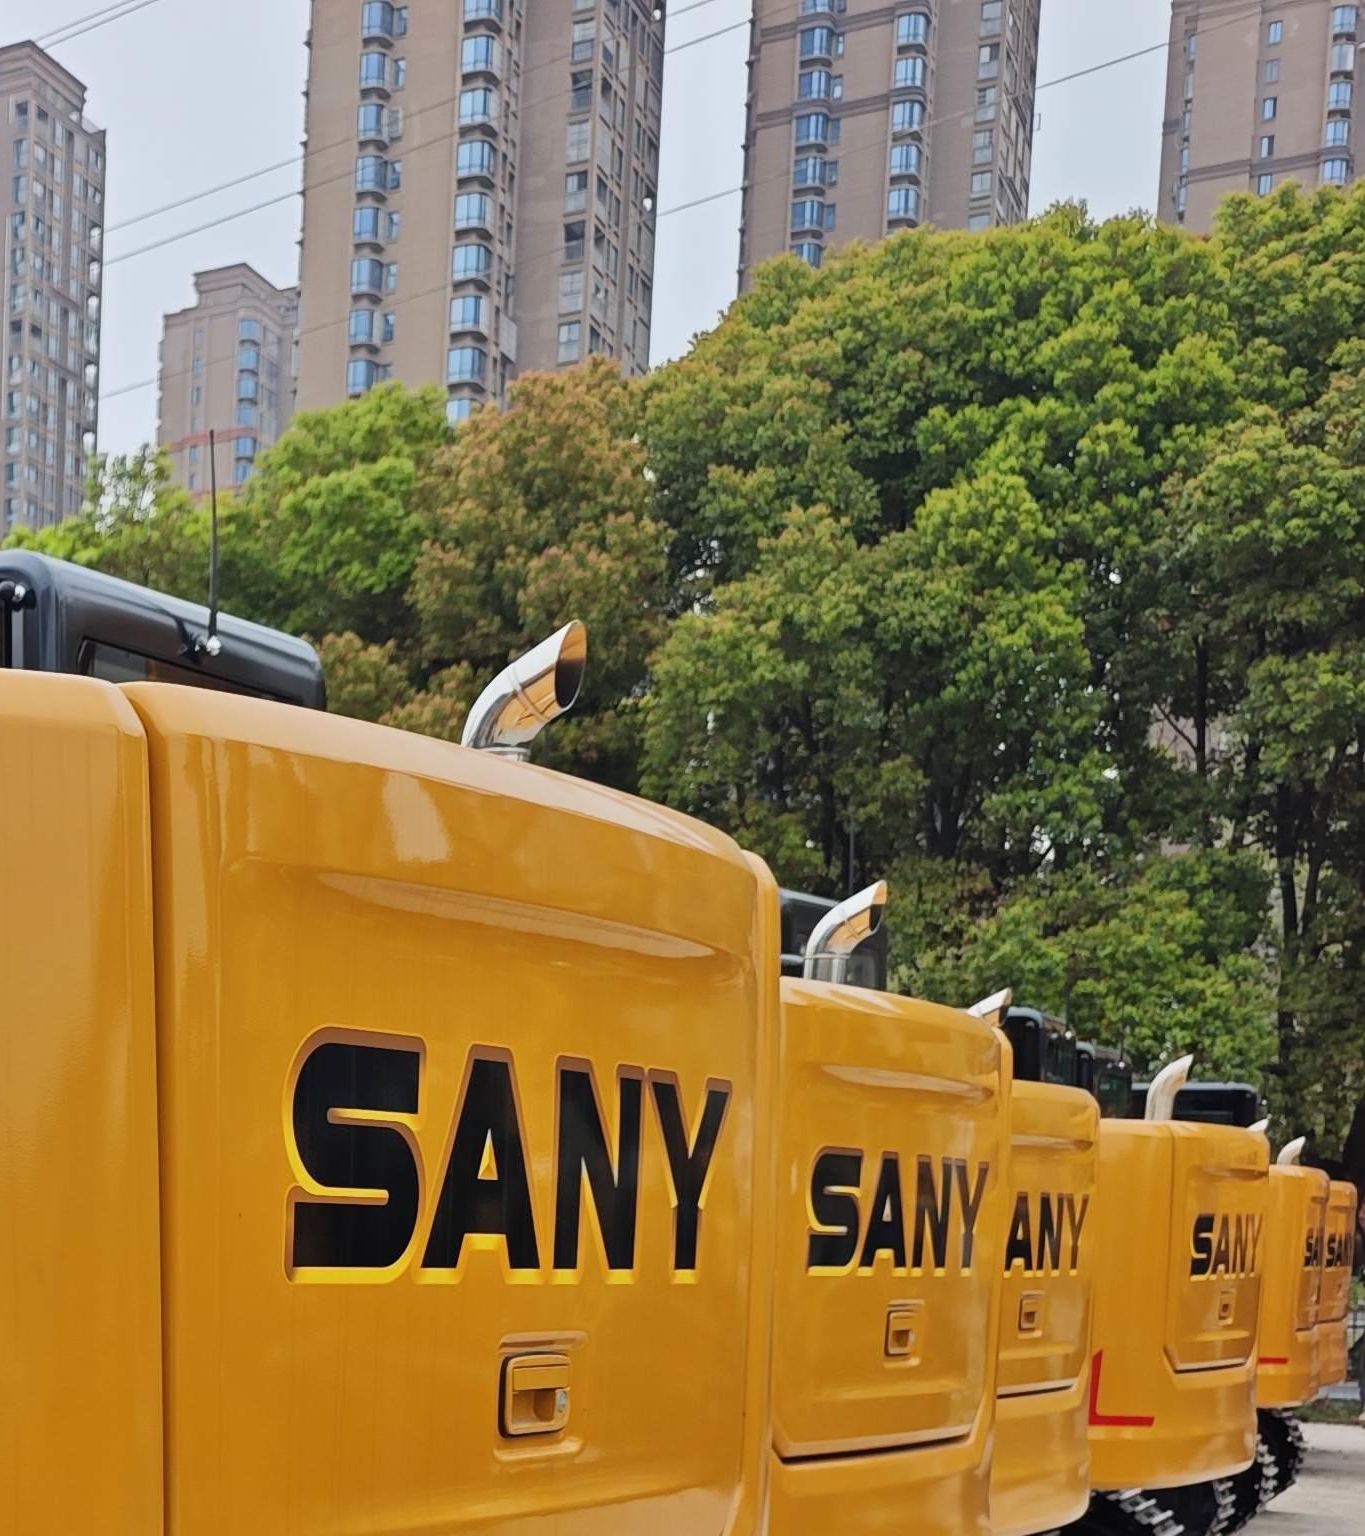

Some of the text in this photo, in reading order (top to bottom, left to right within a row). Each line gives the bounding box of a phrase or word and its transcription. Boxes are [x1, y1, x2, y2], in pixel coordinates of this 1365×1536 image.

[285, 1029, 733, 1285] SANY
[807, 1146, 989, 1276] SANY
[1190, 1213, 1262, 1281] SANY
